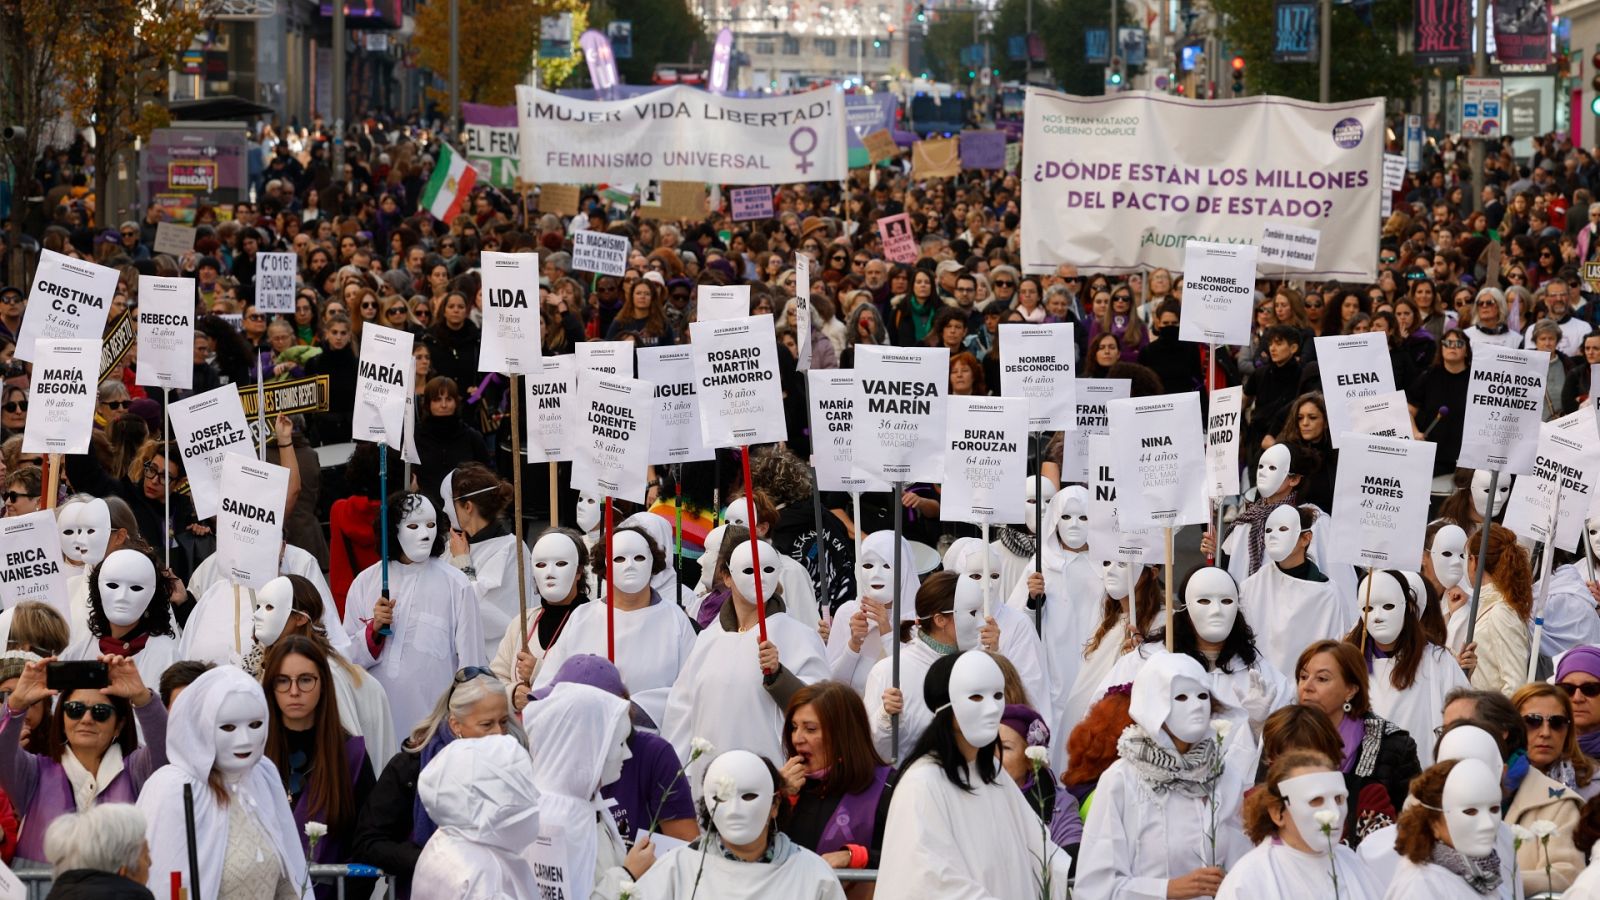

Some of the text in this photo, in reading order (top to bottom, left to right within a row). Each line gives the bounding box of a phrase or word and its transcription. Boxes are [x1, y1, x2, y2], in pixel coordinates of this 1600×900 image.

[527, 102, 621, 122] ¡MUJER
[635, 102, 691, 120] VIDA
[704, 100, 832, 127] LIBERTAD!
[1042, 114, 1062, 124] NOS
[1096, 117, 1139, 125] MATANDO
[1043, 126, 1092, 135] GOBIERNO
[468, 129, 485, 152] EL
[546, 151, 770, 169] FEMINISMO UNIVERSAL
[1034, 159, 1122, 182] ¿DÓNDE
[1129, 162, 1199, 185] ESTÁN
[1208, 169, 1248, 186] LOS
[1256, 169, 1369, 189] MILLONES
[172, 175, 214, 194] FRIDAY
[1067, 190, 1333, 218] DEL PACTO DE ESTADO?
[575, 233, 626, 252] EL MACHISMO
[592, 248, 624, 262] CRIMEN
[1280, 249, 1285, 258] y
[574, 257, 623, 273] CONTRA TODOS
[1200, 275, 1237, 285] NOMBRE
[37, 280, 104, 309] CRISTINA
[1186, 281, 1250, 294] DESCONOCIDO
[488, 288, 528, 309] LIDA
[1213, 295, 1232, 304] años
[52, 299, 81, 317] C.G.
[45, 313, 80, 330] 54 años
[140, 313, 189, 327] REBECCA
[159, 327, 176, 337] años
[707, 346, 761, 363] ROSARIO
[1018, 355, 1056, 364] NOMBRE
[712, 357, 759, 374] MARTÍN
[1005, 363, 1070, 373] DESCONOCIDO
[43, 367, 83, 381] MARÍA
[359, 360, 404, 387] MARÍA
[702, 370, 773, 387] CHAMORRO
[1022, 376, 1055, 384] 46 años
[1337, 372, 1380, 386] ELENA
[1473, 370, 1542, 388] MARÍA ROSA
[37, 380, 87, 395] BEGOÑA
[373, 384, 389, 395] años
[532, 382, 567, 396] SUZAN
[722, 388, 756, 400] 36 años
[862, 379, 939, 398] VANESA
[1346, 388, 1377, 398] 68 años
[1487, 382, 1528, 398] GÓMEZ
[44, 398, 74, 408] 89 años
[538, 396, 561, 409] ANN
[661, 401, 691, 411] 35 años
[819, 398, 853, 410] MARÍA
[868, 396, 931, 416] MARÍN
[1472, 394, 1538, 411] FERNÁNDEZ
[591, 401, 634, 419] RAQUEL
[1488, 411, 1519, 423] 52 años
[546, 413, 562, 422] años
[587, 412, 637, 431] LORENTE
[1209, 412, 1237, 429] KIRSTY
[189, 421, 233, 443] JOSEFA
[878, 419, 919, 431] 36 años
[592, 424, 630, 441] PARDO
[964, 429, 1005, 440] BURAN
[1209, 430, 1233, 446] WARD
[184, 430, 246, 459] GONZÁLEZ
[593, 440, 626, 455] 58 años
[833, 437, 844, 446] 60
[951, 440, 1017, 453] FOROUZAN
[1141, 436, 1173, 448] NINA
[203, 452, 224, 466] 79 añ
[966, 456, 1001, 466] 64 años
[1139, 451, 1179, 463] 44 años
[1536, 455, 1583, 481] CARMEN
[1364, 475, 1401, 488] MARÍA
[1537, 483, 1547, 494] 43
[1360, 485, 1403, 499] TORRES
[222, 497, 276, 525] SANDRA
[1360, 499, 1400, 513] 48 años
[231, 520, 260, 536] 41 años
[6, 547, 46, 566] ERICA
[0, 561, 59, 583] VANESSA
[17, 582, 49, 596] 22 años
[534, 862, 563, 883] CARMEN
